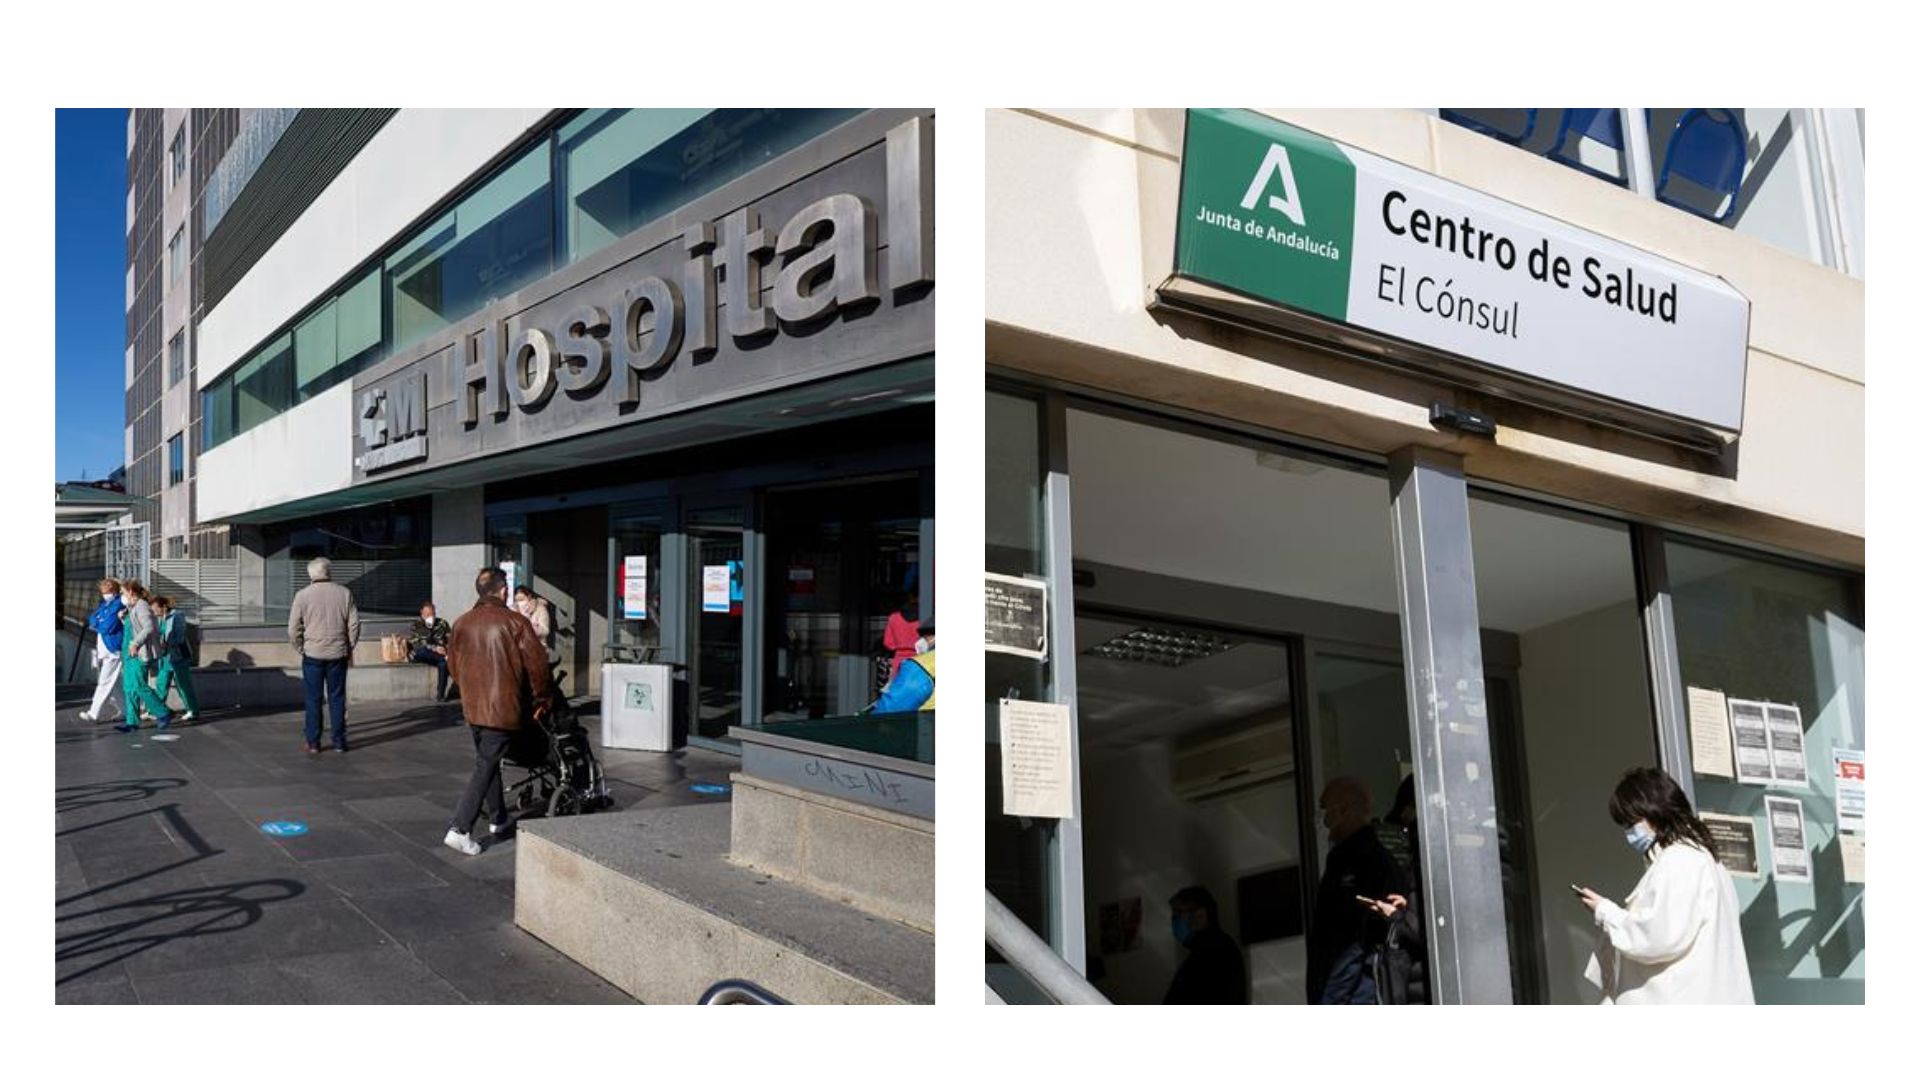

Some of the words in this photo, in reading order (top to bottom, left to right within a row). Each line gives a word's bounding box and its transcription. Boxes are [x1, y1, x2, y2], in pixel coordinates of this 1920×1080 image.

[455, 115, 934, 424] Hospital
[1196, 205, 1241, 232] Junta
[1245, 219, 1264, 239] de
[1266, 225, 1340, 260] Andalucía
[1382, 190, 1517, 271] Centro
[1528, 239, 1571, 289] de
[1582, 257, 1677, 324] Salud
[1378, 264, 1404, 307] El
[1416, 275, 1519, 338] Cónsul
